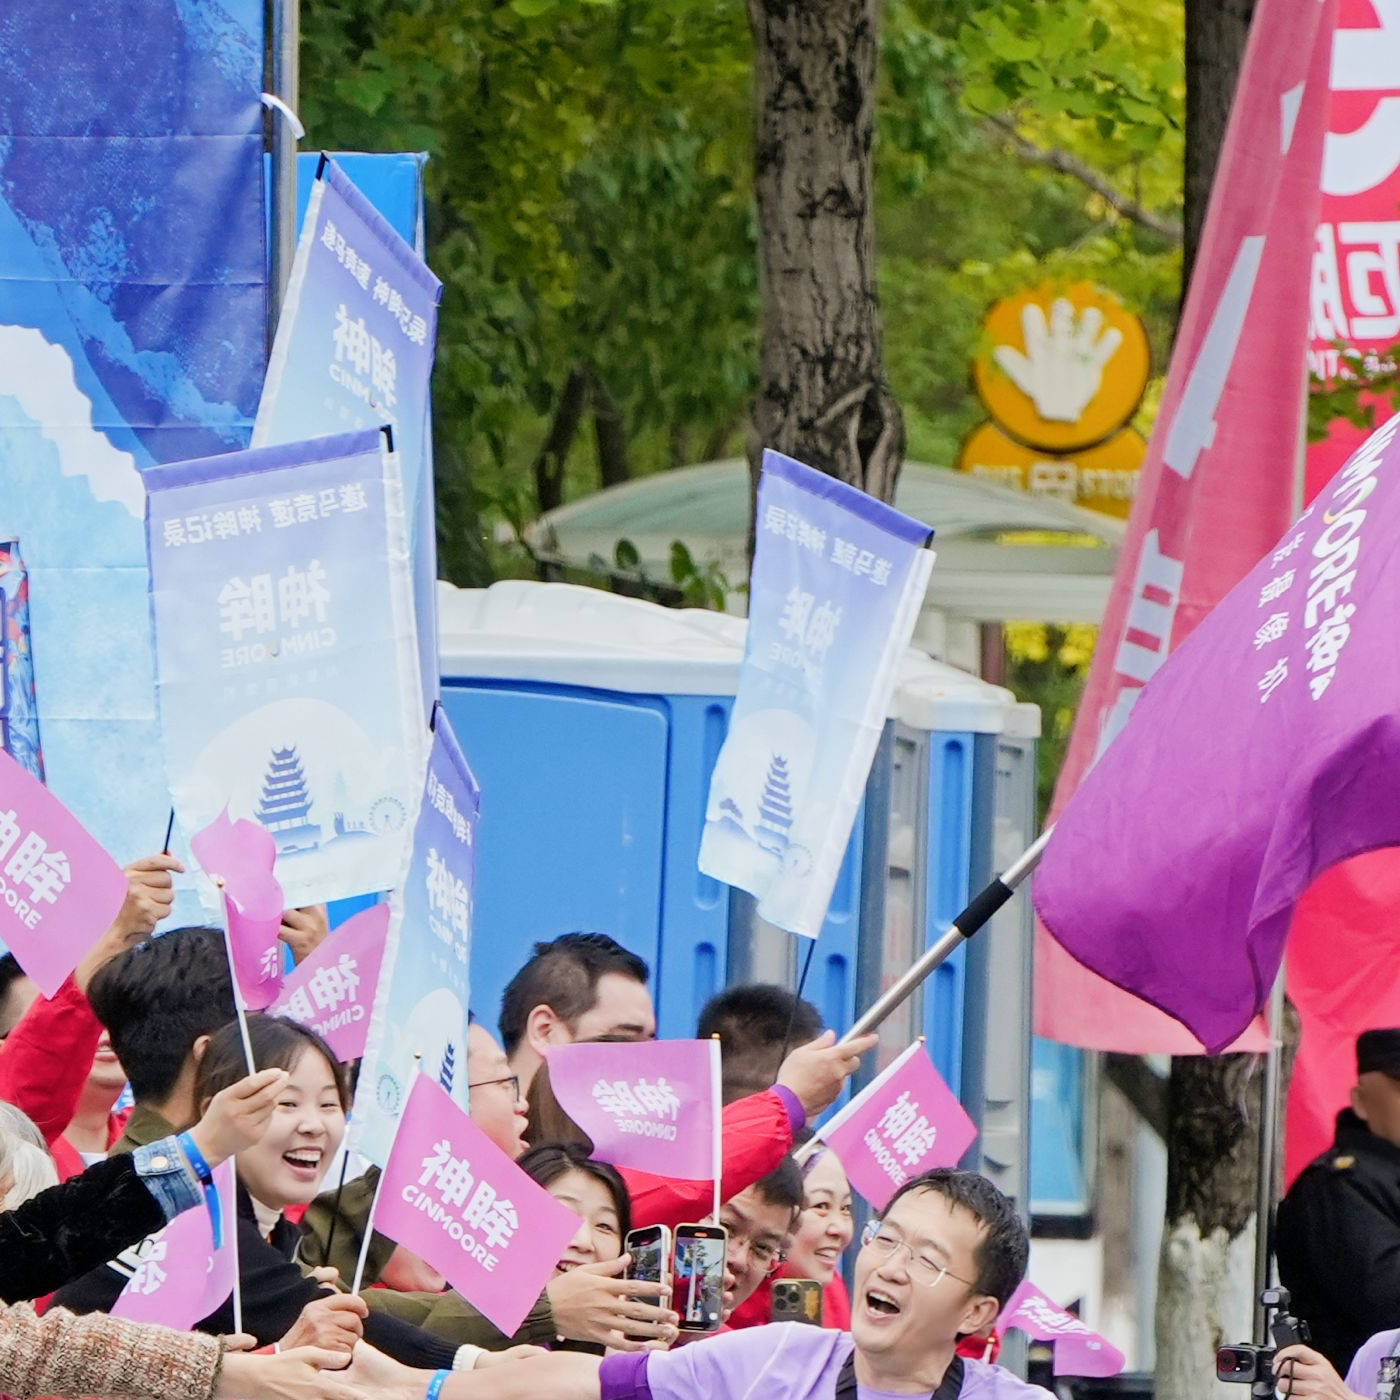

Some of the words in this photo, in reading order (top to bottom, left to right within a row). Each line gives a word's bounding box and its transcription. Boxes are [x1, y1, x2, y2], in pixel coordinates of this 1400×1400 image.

[877, 1091, 936, 1166] 神眸
[401, 1185, 499, 1272] CINMOORE
[418, 1139, 519, 1249] 神眸
